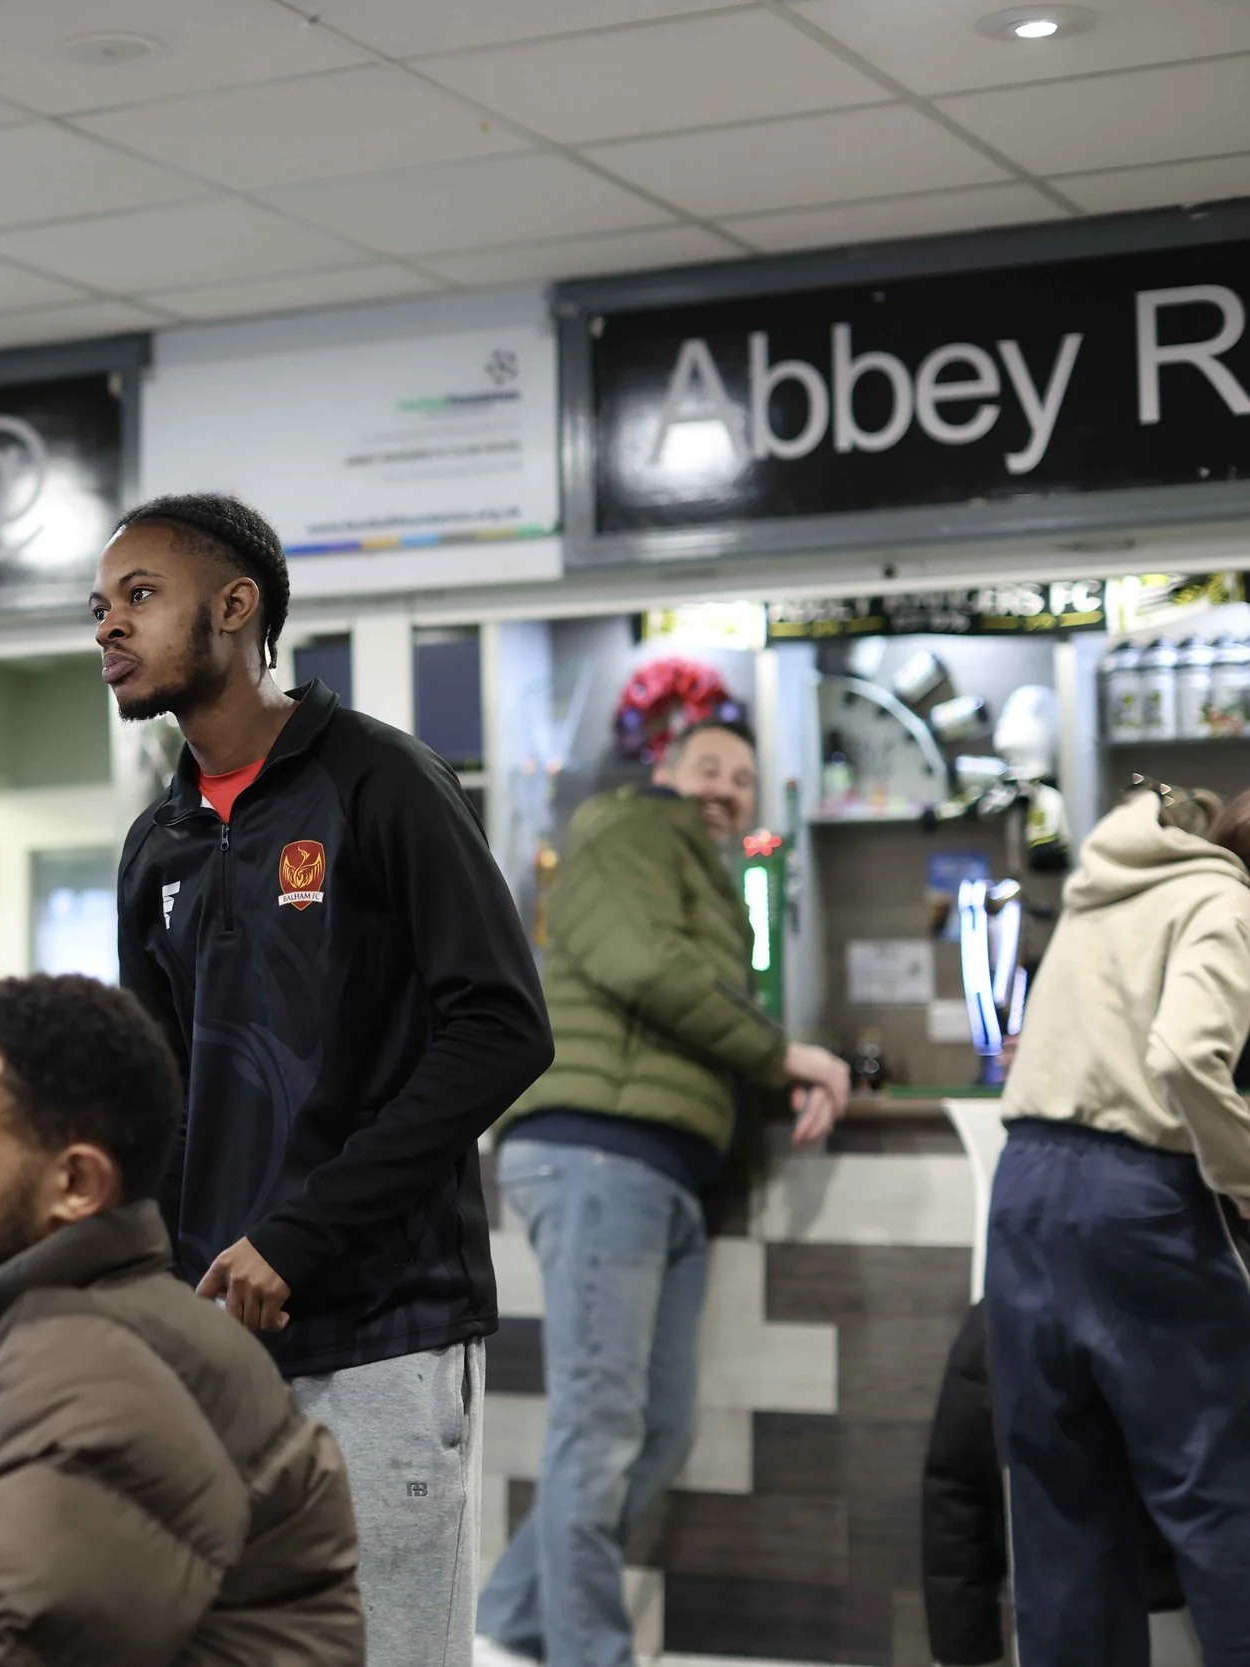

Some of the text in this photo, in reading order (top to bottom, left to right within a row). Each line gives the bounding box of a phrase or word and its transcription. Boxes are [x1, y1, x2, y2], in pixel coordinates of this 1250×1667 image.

[649, 284, 1250, 475] Abbey R
[1050, 579, 1103, 616] FC
[282, 892, 321, 903] BALHAM FC
